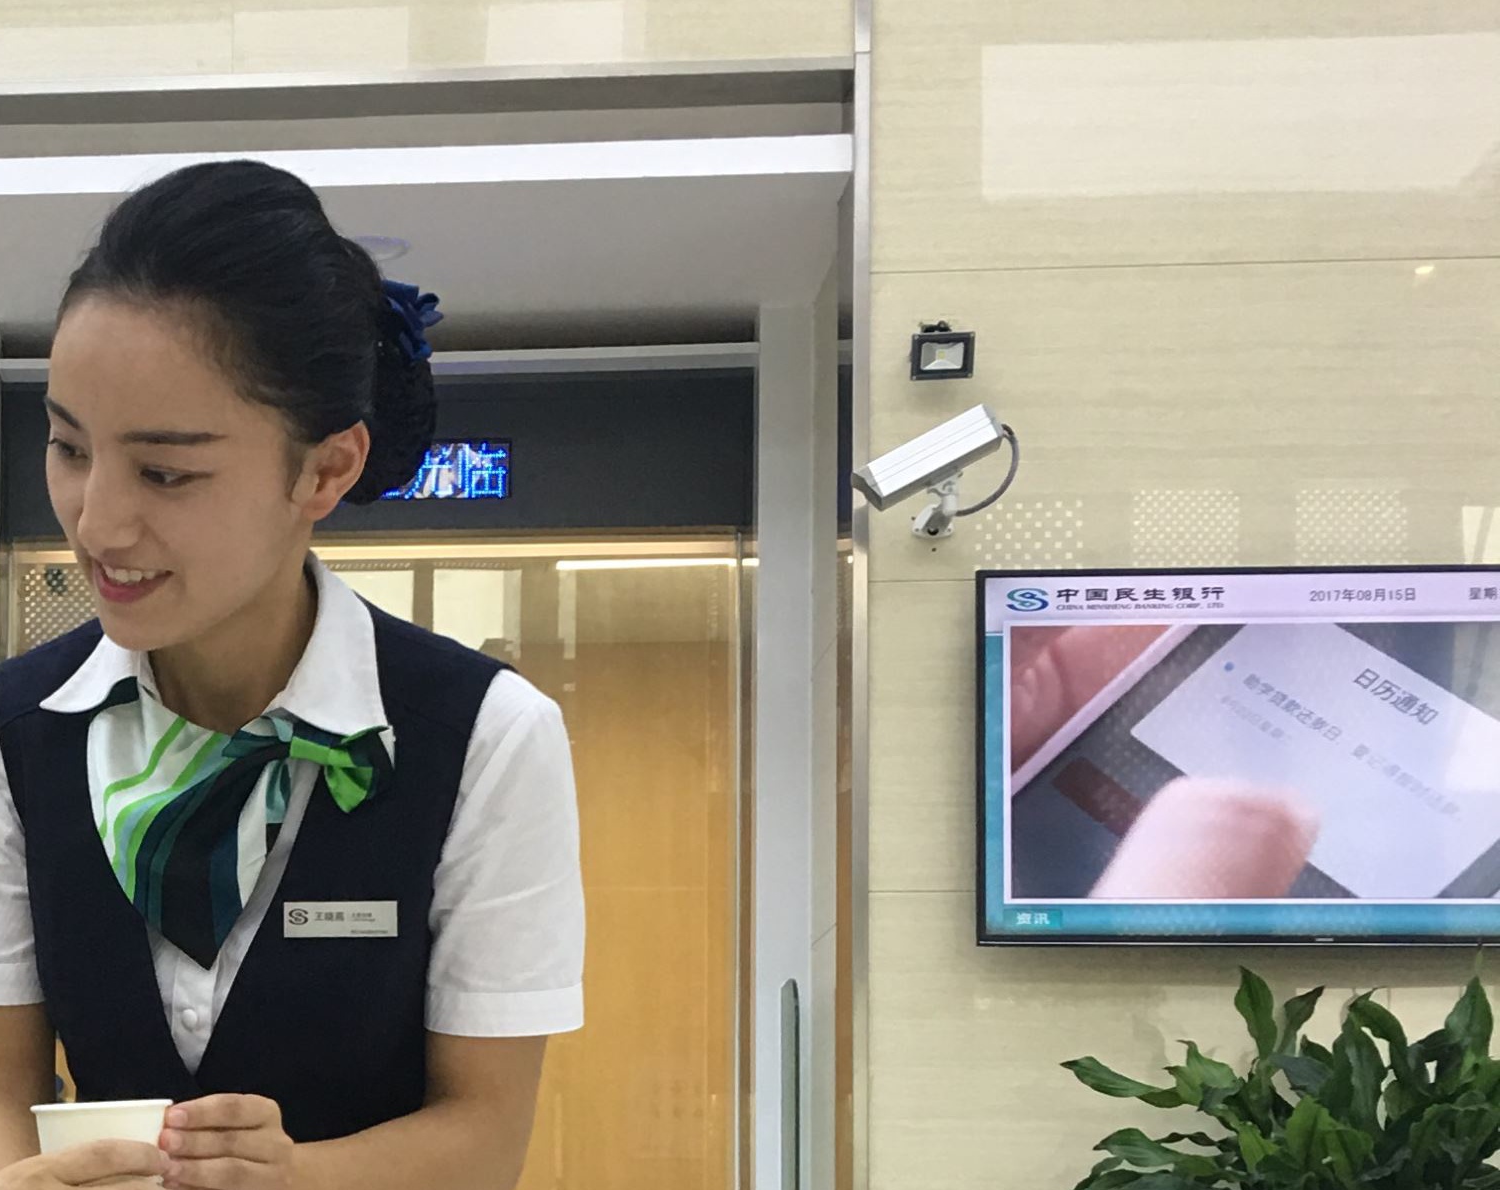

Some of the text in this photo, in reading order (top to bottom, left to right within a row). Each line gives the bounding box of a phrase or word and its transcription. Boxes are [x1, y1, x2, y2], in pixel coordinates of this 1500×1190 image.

[385, 442, 506, 498] 光临
[1056, 587, 1225, 603] 中国民生银行
[1309, 587, 1500, 602] 2017年08月15日 星期
[1354, 667, 1439, 726] 日历通知
